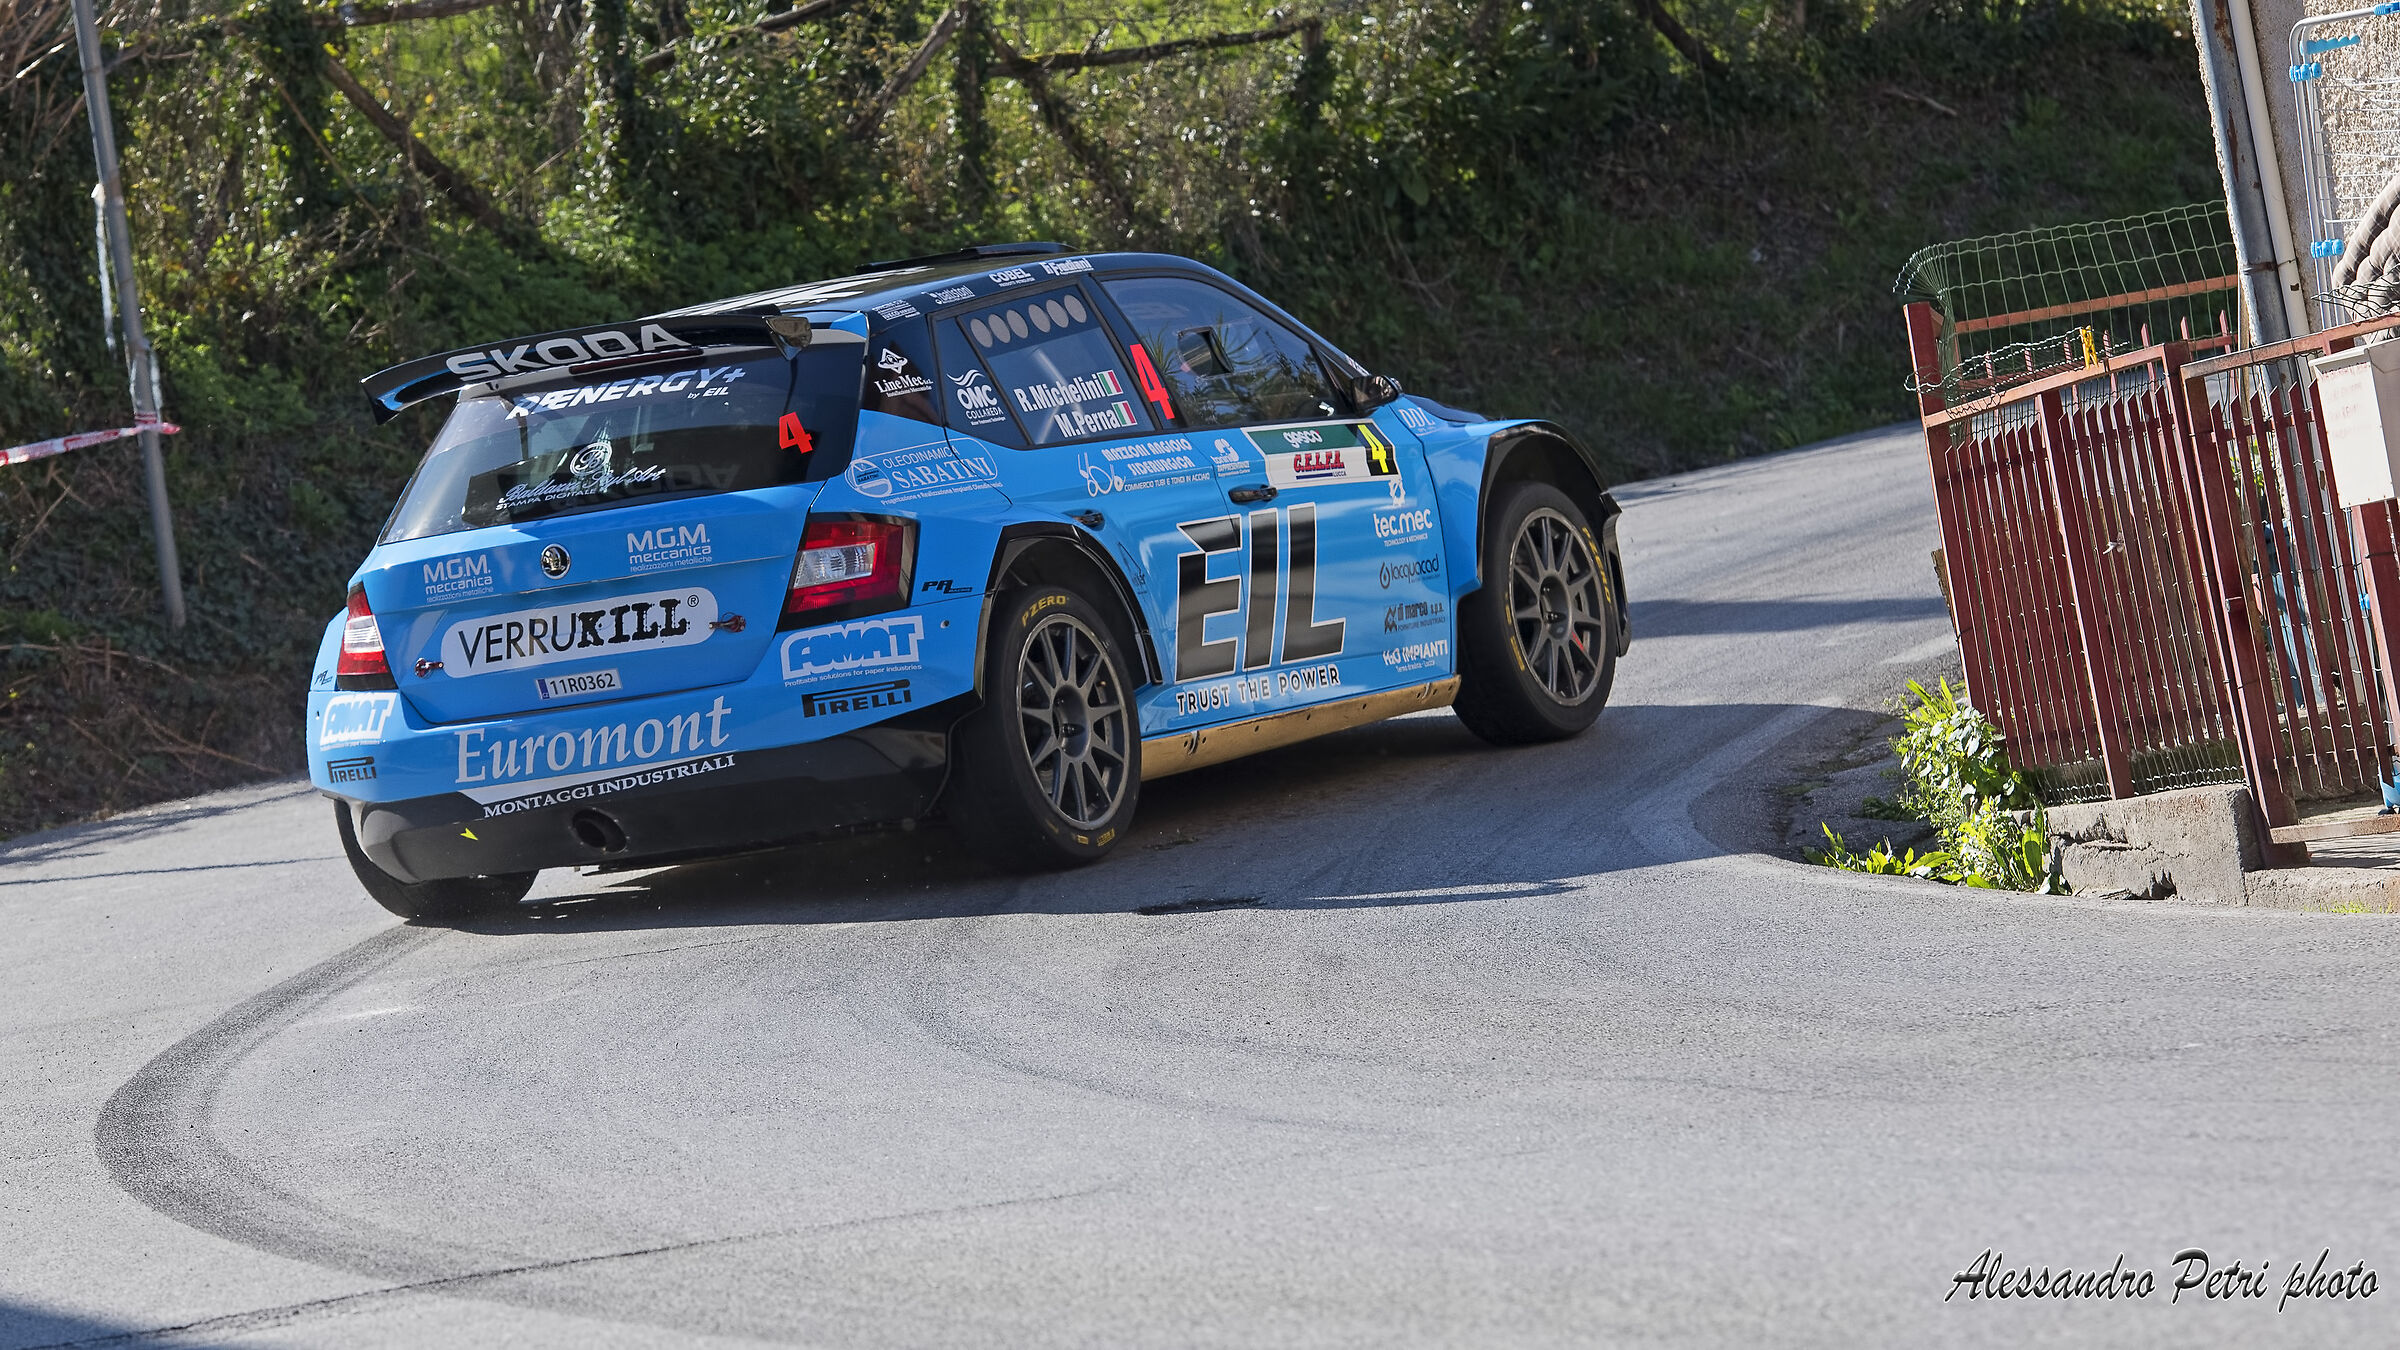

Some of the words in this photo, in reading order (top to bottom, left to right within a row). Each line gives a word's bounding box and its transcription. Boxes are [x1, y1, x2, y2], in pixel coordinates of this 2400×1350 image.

[988, 267, 1032, 283] COBEL
[445, 323, 692, 382] SKODA
[687, 391, 699, 400] by
[703, 386, 729, 398] EIL
[1013, 373, 1108, 413] R.Michelini
[1130, 343, 1176, 420] 4
[956, 384, 998, 410] OMC
[778, 411, 813, 454] 4
[1053, 408, 1121, 438] M.Perna
[882, 444, 960, 470] OLEODINAMICA
[1357, 424, 1389, 473] 4
[891, 456, 996, 490] SABATINI
[1127, 455, 1195, 476] SIDERURGICA
[495, 498, 541, 511] STAMPA
[544, 487, 597, 501] DIGITALE
[627, 523, 711, 553] M.G.M.
[1373, 508, 1433, 538] tec.mec
[423, 554, 492, 584] M.G.M.
[629, 545, 712, 565] meccanica
[630, 561, 674, 572] realizzazioni
[425, 576, 493, 596] meccanica
[1174, 501, 1346, 684] EIL
[1402, 639, 1449, 663] IMPIANTI
[550, 673, 616, 696] 11R0362
[784, 676, 818, 687] Profitable
[819, 670, 852, 681] solutions
[852, 668, 864, 676] for
[865, 667, 886, 677] paper
[886, 664, 922, 673] industries
[1176, 686, 1231, 715] TRUST
[1237, 674, 1271, 703] THE
[1278, 663, 1342, 695] POWER
[801, 679, 912, 718] PIRELLI
[454, 695, 732, 784] Euromont
[327, 756, 377, 784] PIRELLI
[483, 785, 596, 818] MONTAGGI
[598, 754, 736, 796] INDUSTRIALI
